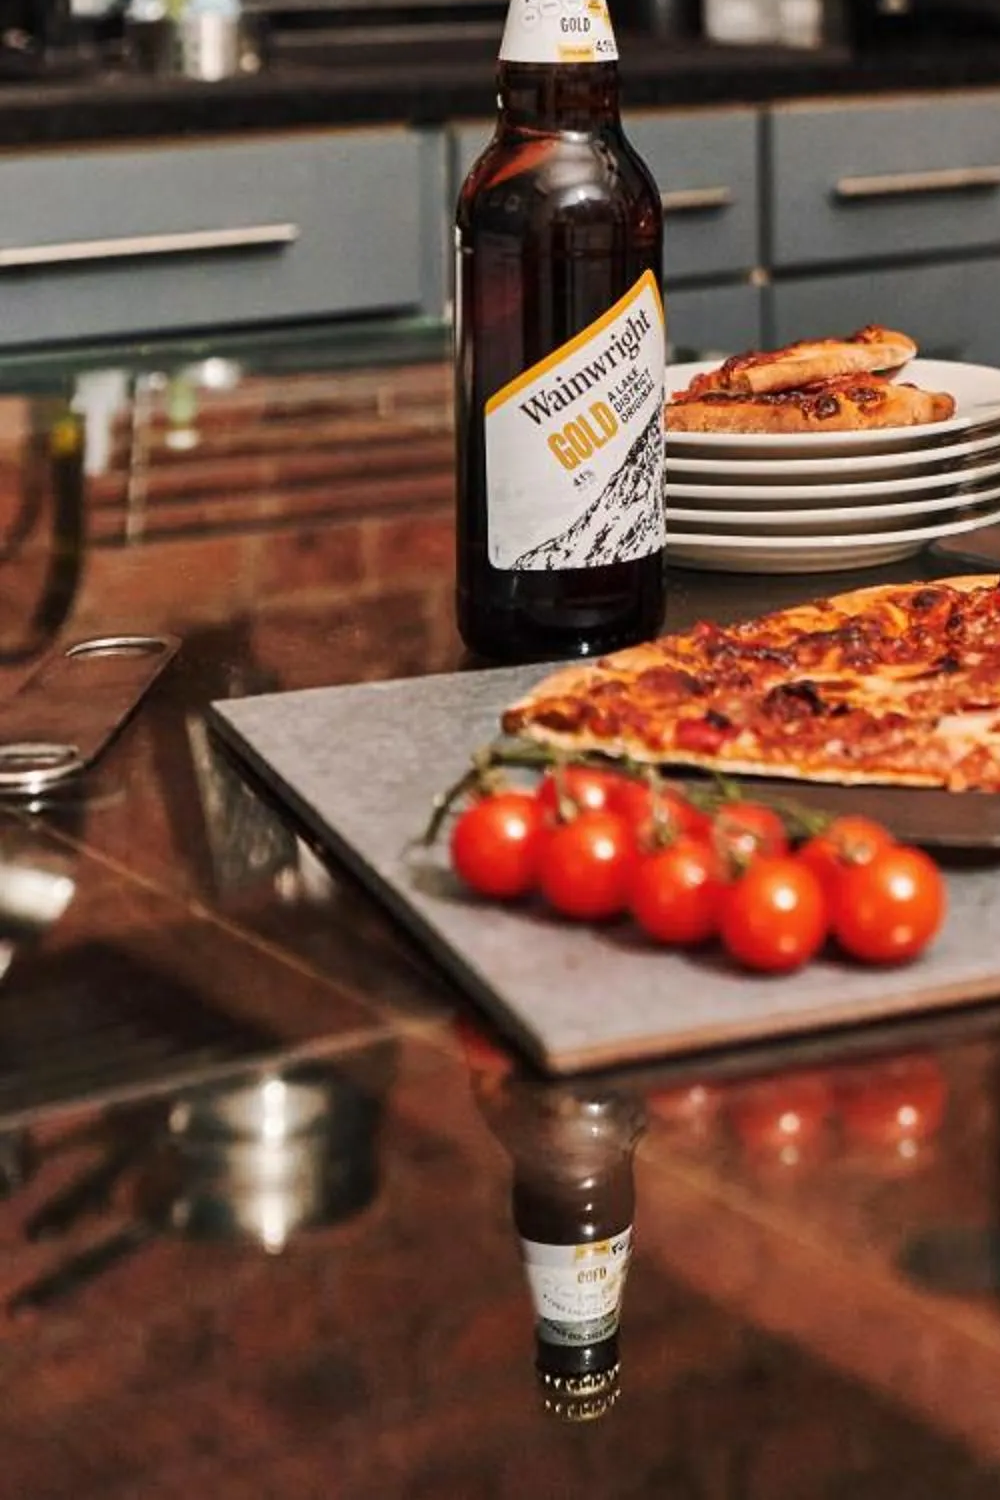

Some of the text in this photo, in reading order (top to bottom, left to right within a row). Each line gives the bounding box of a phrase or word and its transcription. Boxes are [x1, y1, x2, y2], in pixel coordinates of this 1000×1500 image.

[560, 17, 591, 32] GOLD
[519, 309, 651, 425] Wainwright
[608, 367, 639, 402] A LAKE
[614, 368, 651, 413] DISTRICT
[621, 383, 655, 423] ORIGINAL
[547, 401, 619, 470] GOLD
